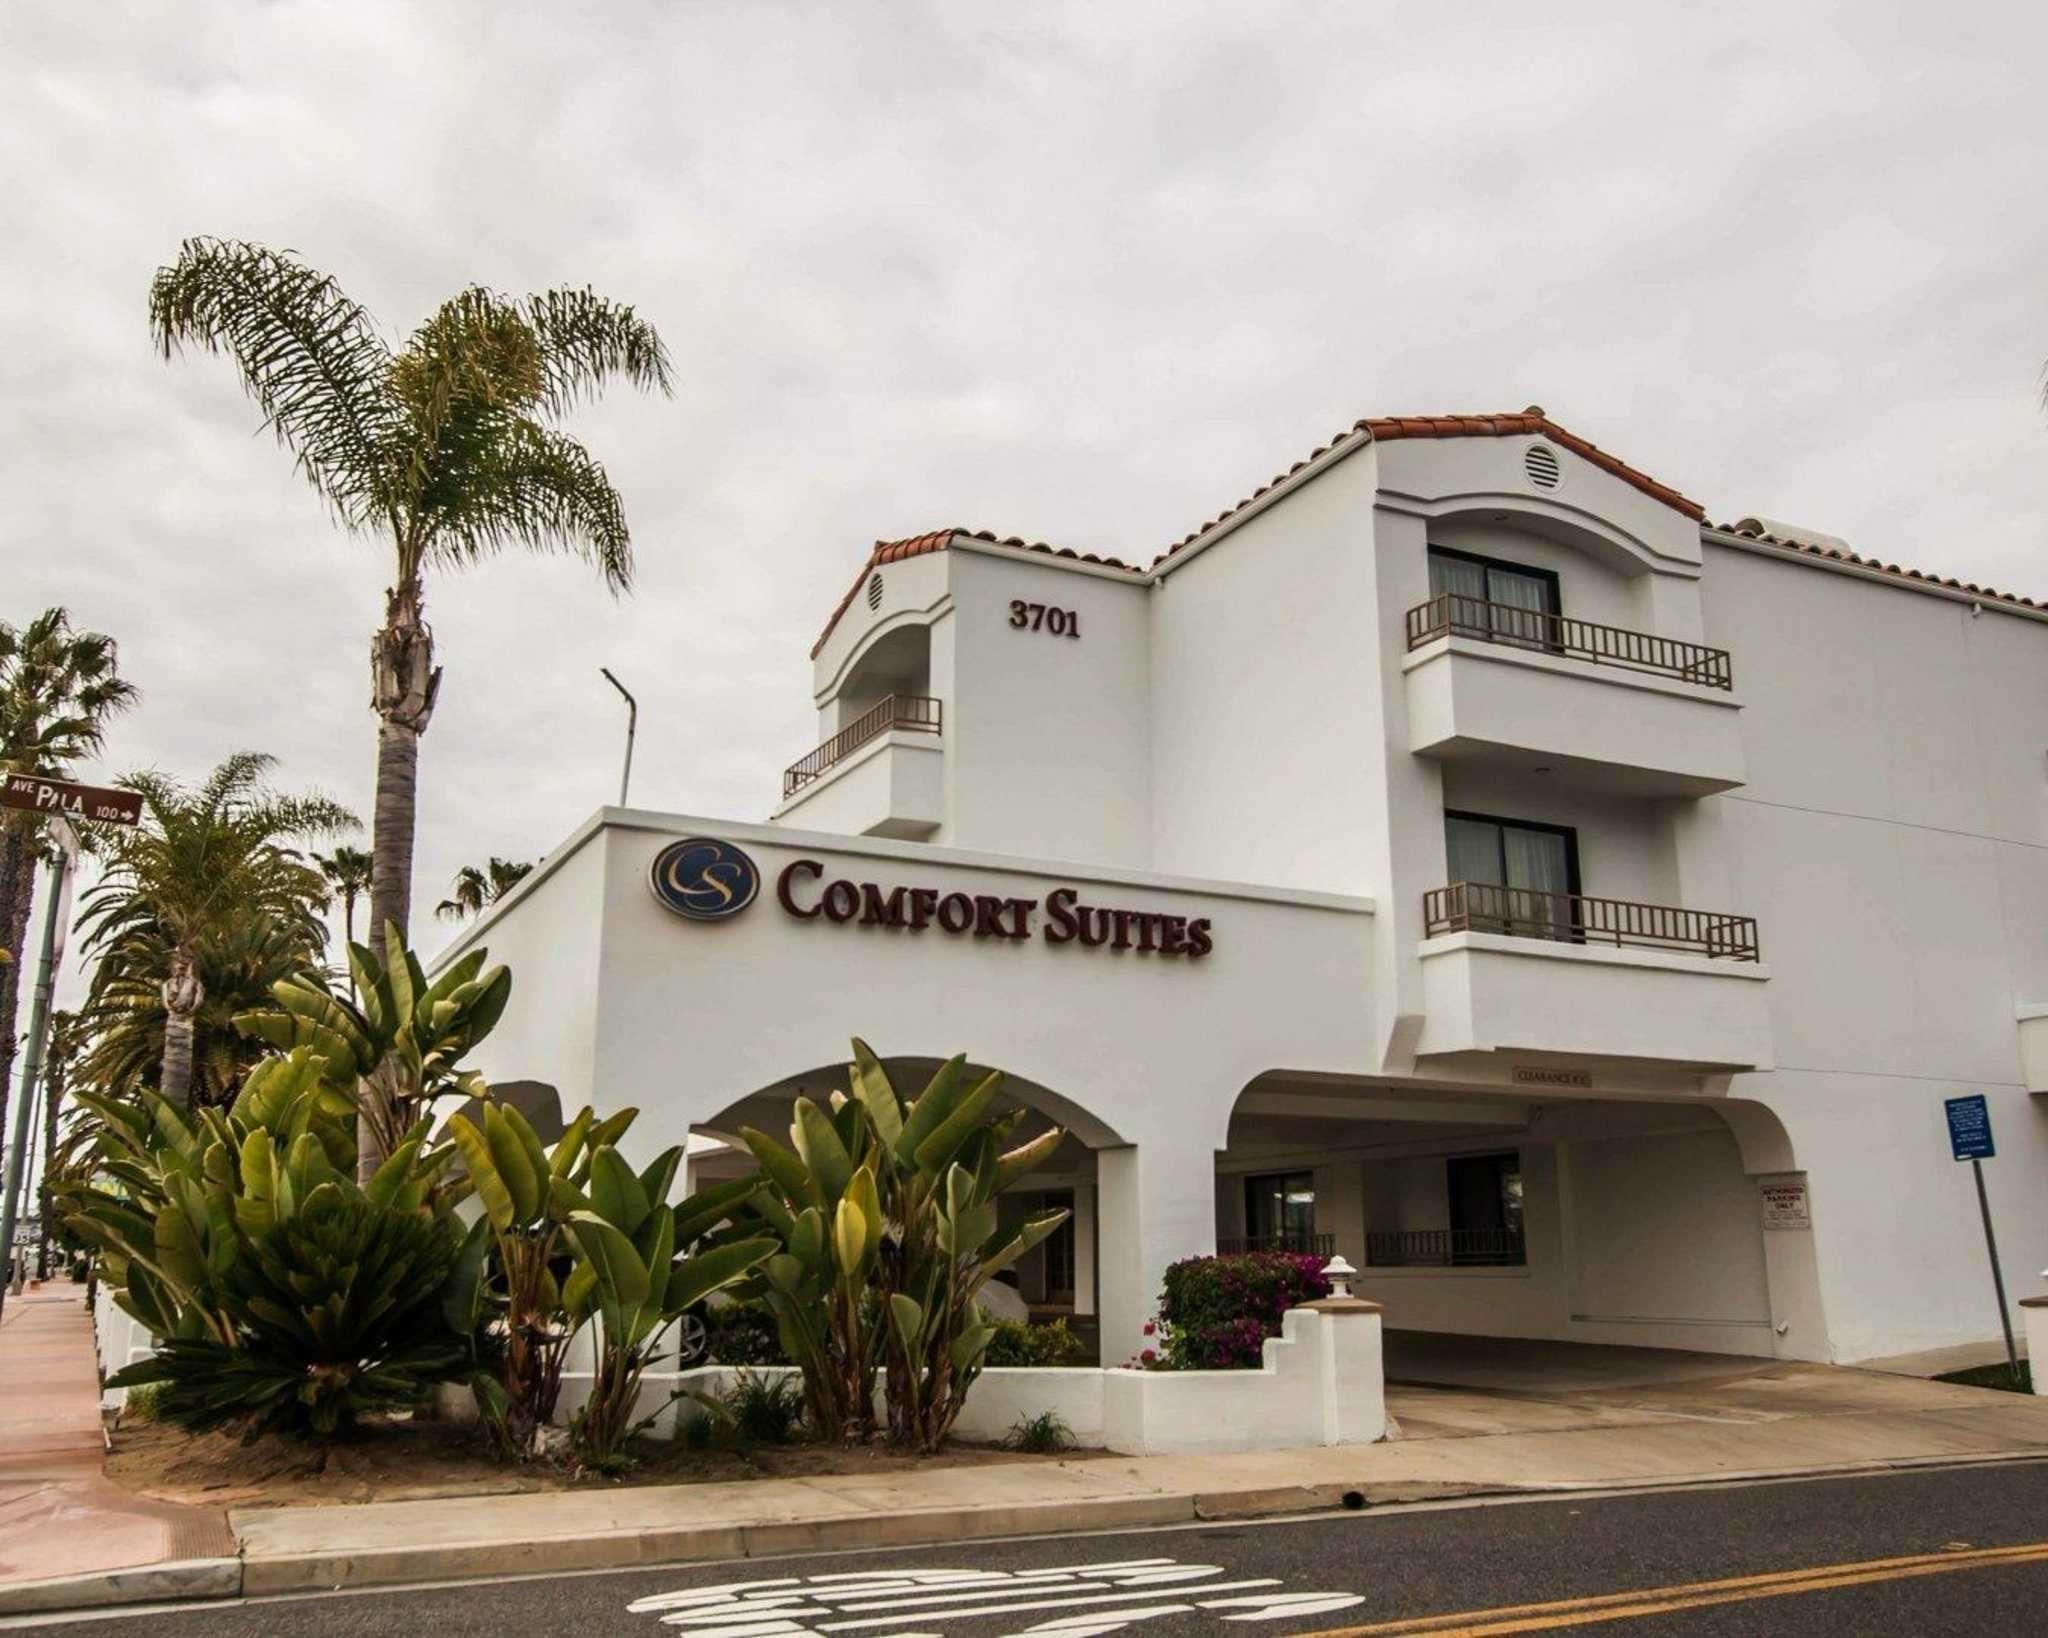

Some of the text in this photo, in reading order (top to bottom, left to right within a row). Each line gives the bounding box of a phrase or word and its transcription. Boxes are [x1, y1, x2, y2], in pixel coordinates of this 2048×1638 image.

[1008, 600, 1080, 638] 3701
[11, 780, 118, 819] AVE PALA 100
[777, 859, 1212, 957] COMFORT SUITES
